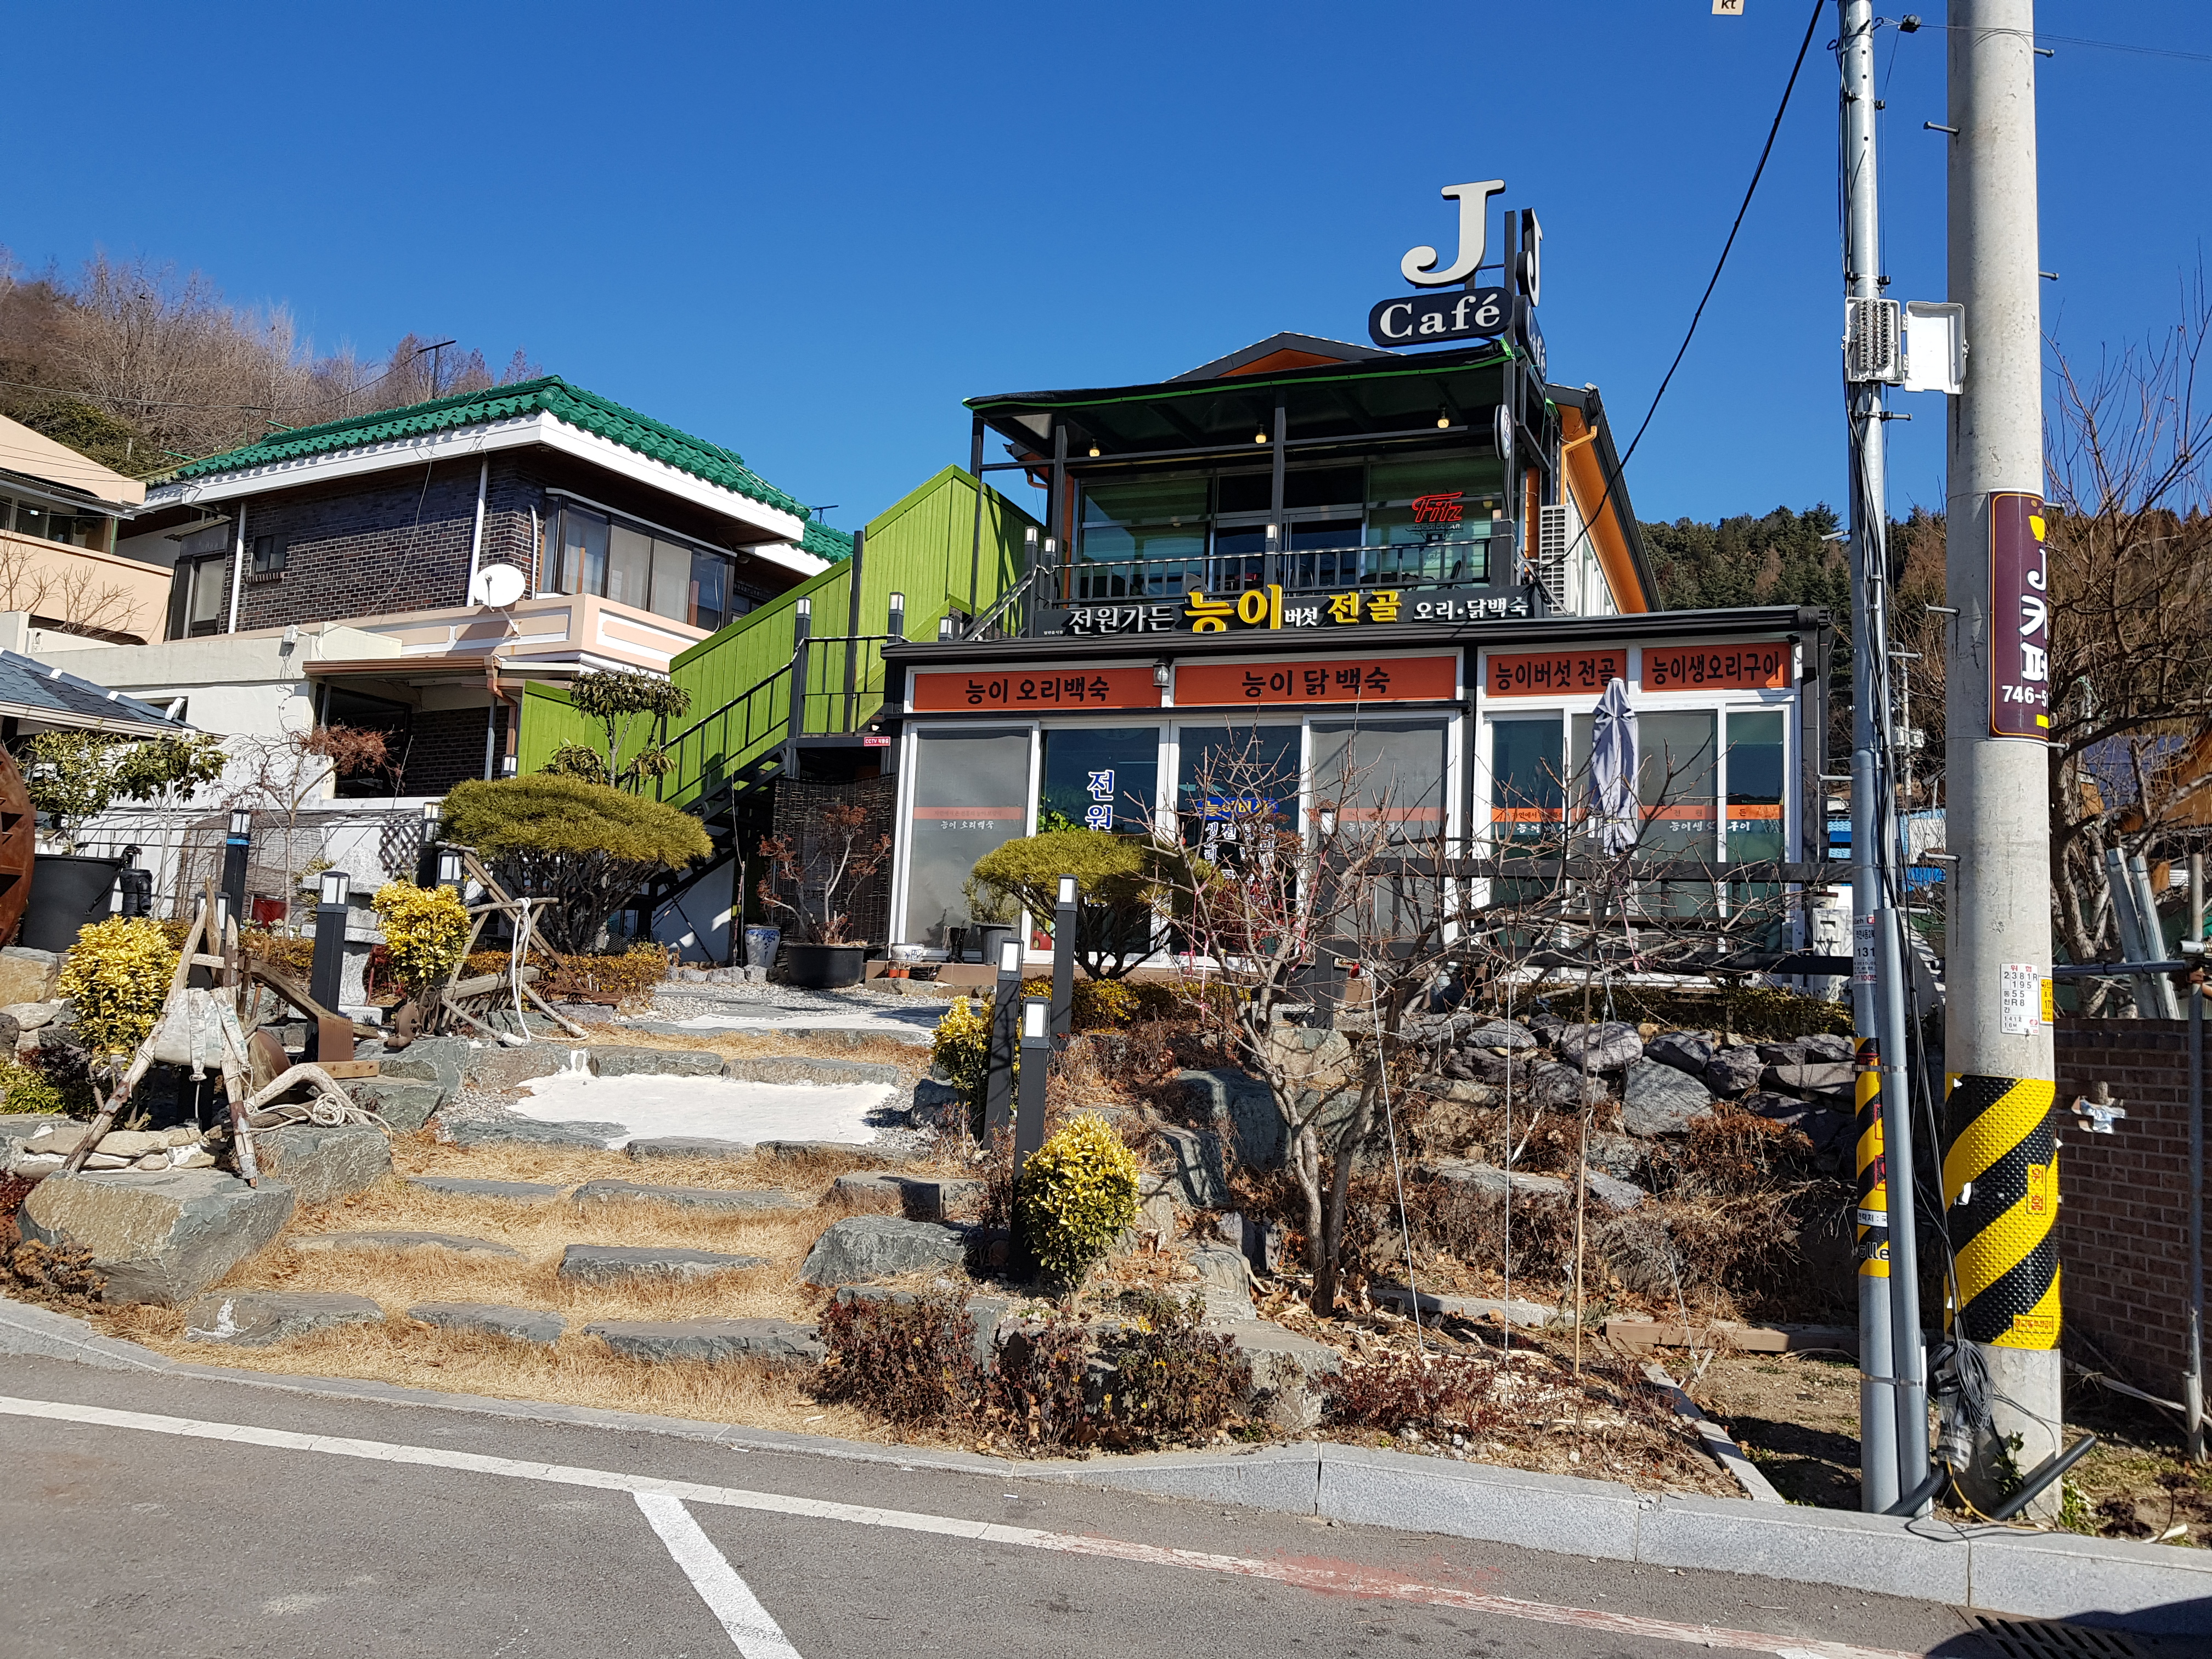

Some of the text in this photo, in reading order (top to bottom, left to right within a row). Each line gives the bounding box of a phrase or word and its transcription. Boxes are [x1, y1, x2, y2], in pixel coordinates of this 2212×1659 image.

[1401, 179, 1505, 289] J
[1380, 294, 1500, 338] Café
[1527, 305, 1546, 377] Café
[1412, 491, 1463, 523] Fitz
[1069, 606, 1175, 635] 전원가든
[1185, 584, 1283, 633] 능이
[1284, 607, 1317, 627] 버섯
[1328, 590, 1402, 624] 전골
[1242, 670, 1293, 698] 능이
[1495, 658, 1616, 690] 능이버섯 전골
[1652, 651, 1779, 685] 능이생오리구이
[966, 676, 1110, 704] 능이 오리백숙
[940, 820, 957, 830] 능이
[1669, 821, 1751, 832] 능이생오구이
[2031, 1168, 2044, 1211] 위험
